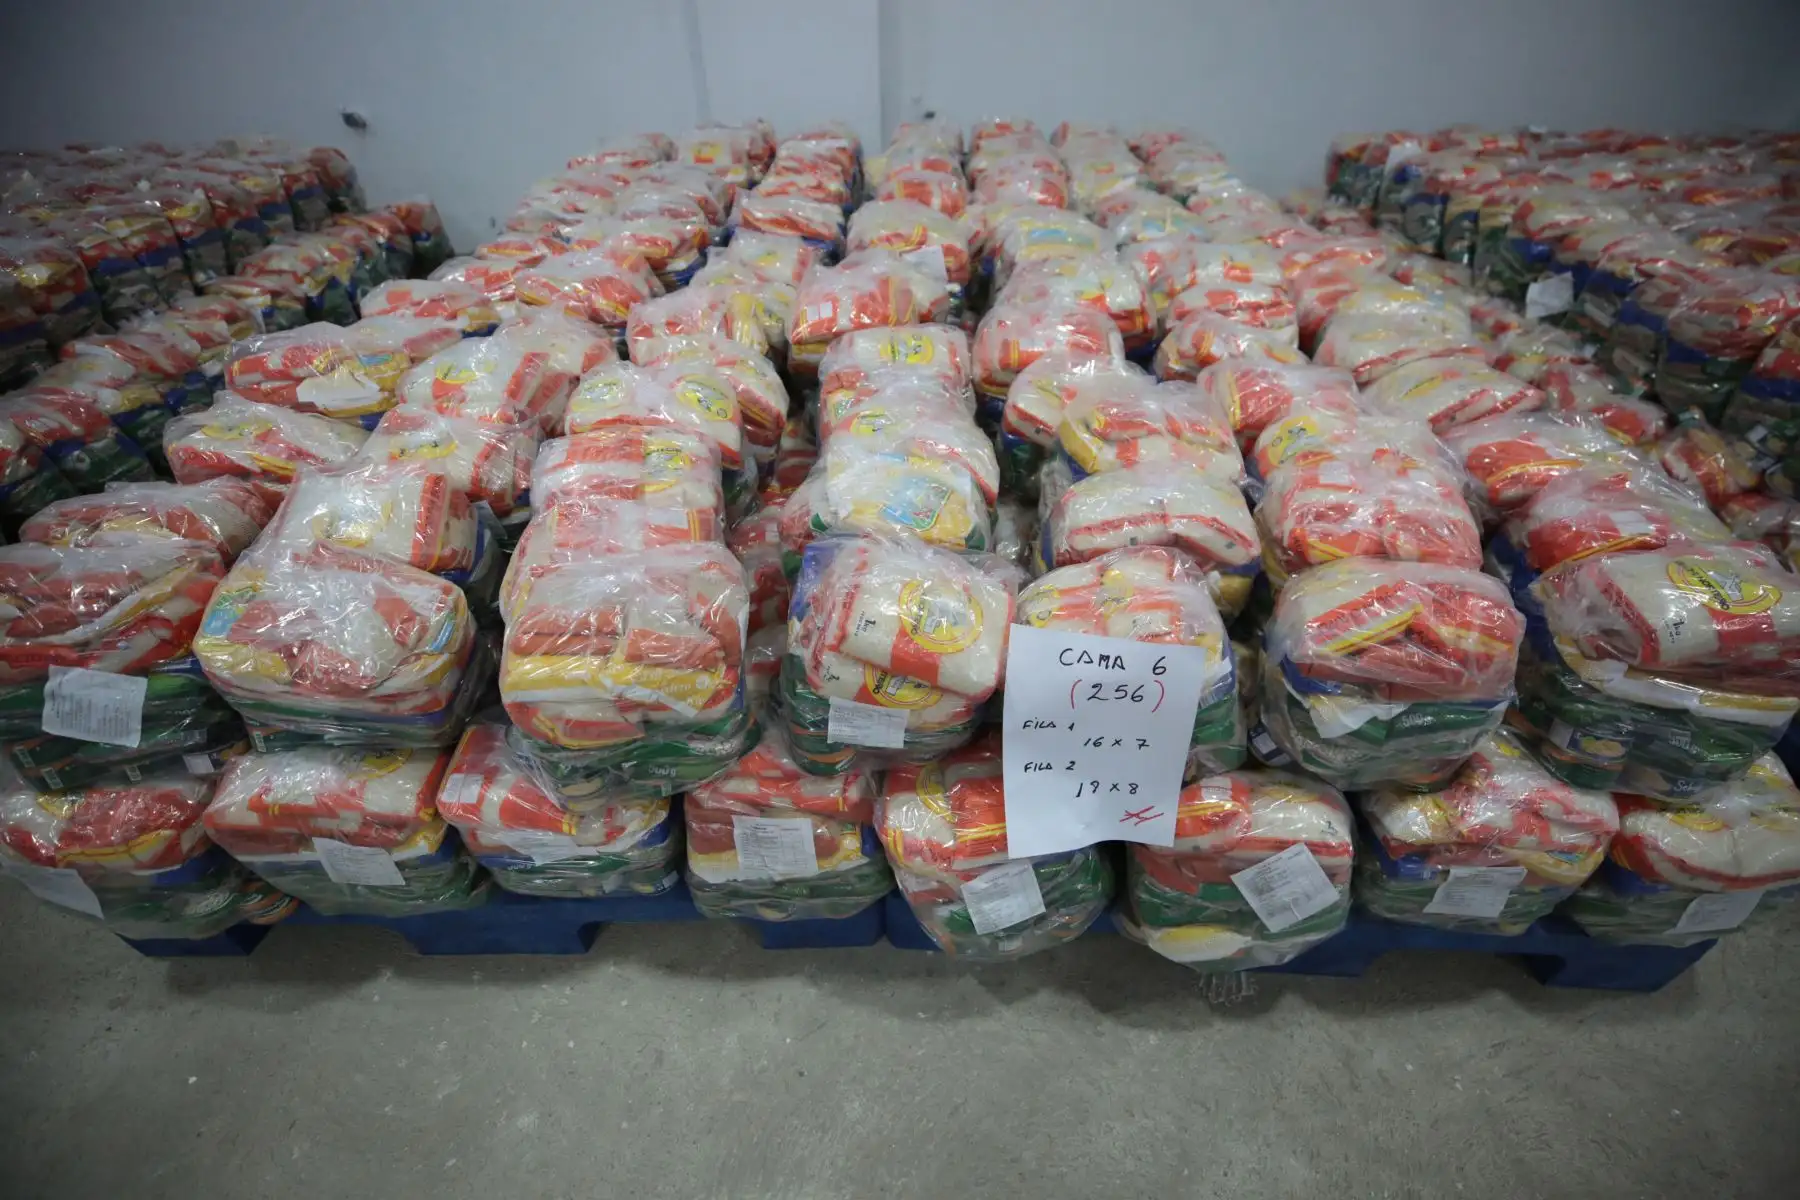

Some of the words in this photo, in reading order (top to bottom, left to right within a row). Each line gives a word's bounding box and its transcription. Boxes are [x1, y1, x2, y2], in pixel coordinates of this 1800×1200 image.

[1059, 647, 1126, 671] CAMA
[1152, 655, 1167, 676] 6
[1070, 678, 1165, 713] (256)
[1068, 722, 1075, 731] 1
[1083, 736, 1105, 747] 16
[1135, 738, 1149, 750] 7
[1065, 760, 1076, 771] 2
[1128, 782, 1139, 795] 8
